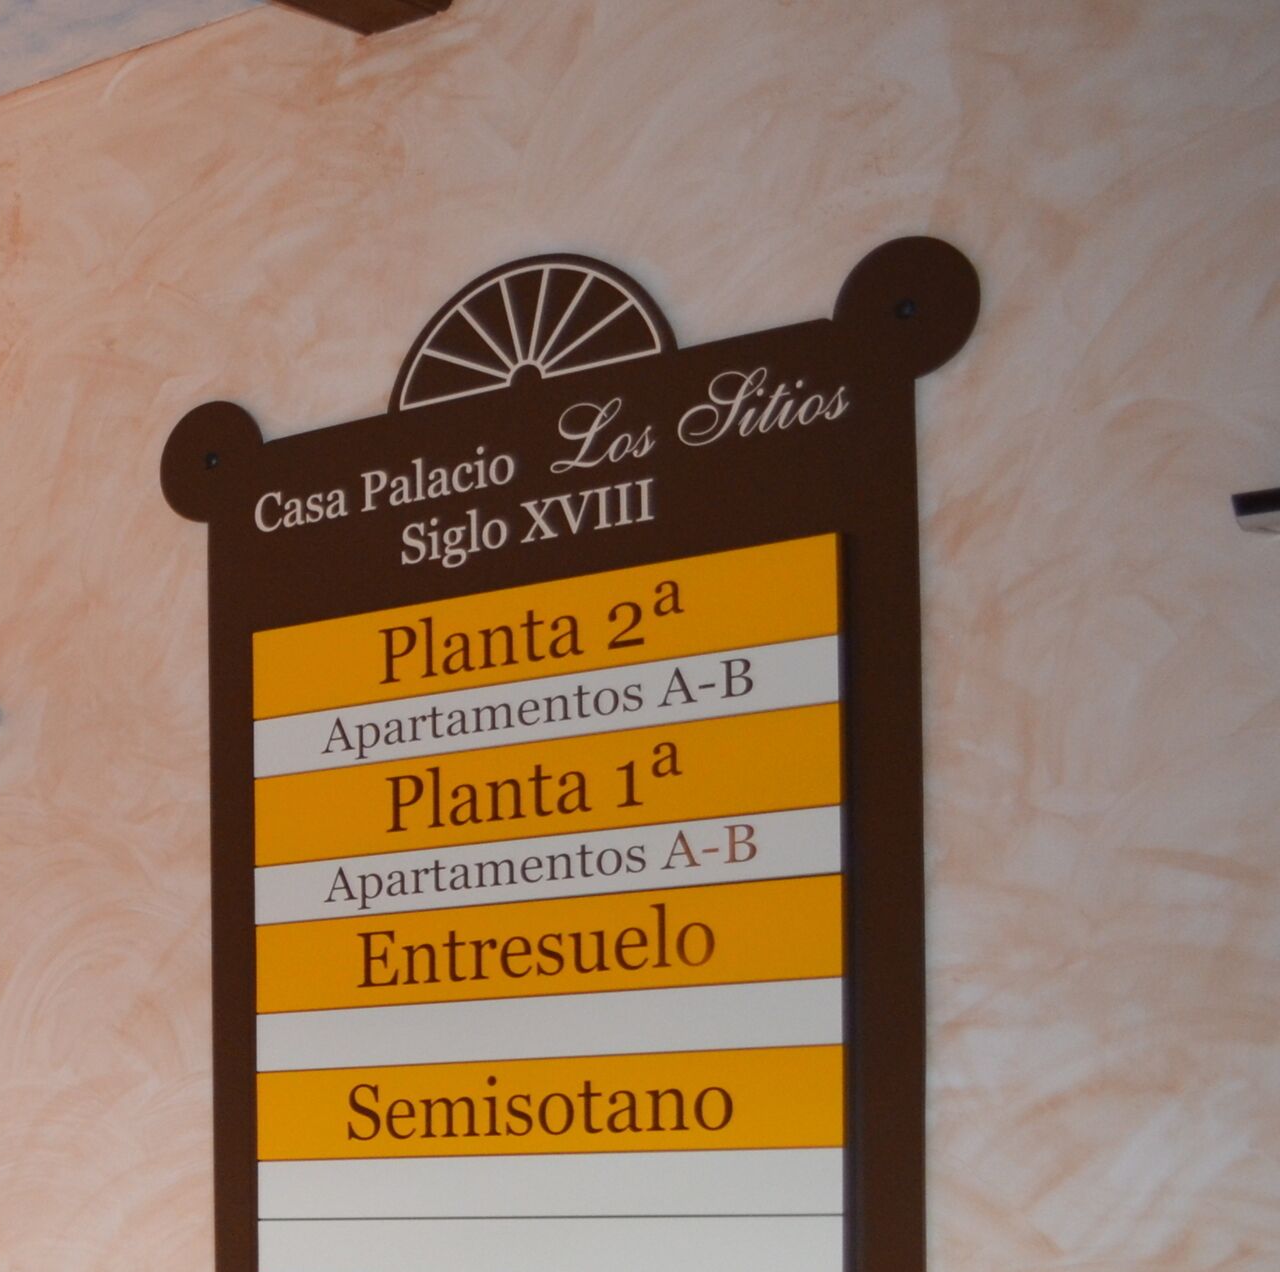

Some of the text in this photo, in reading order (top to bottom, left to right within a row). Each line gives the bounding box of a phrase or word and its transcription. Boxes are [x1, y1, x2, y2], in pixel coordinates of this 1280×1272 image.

[253, 366, 850, 534] Casa Palacio Los Sitios
[399, 478, 656, 569] Siglo XVIII
[378, 608, 585, 685] Planta
[321, 657, 755, 760] Apartamentos A-B
[385, 760, 592, 833] Planta
[323, 824, 758, 910] Apartamentos A-B
[356, 903, 716, 988] Entresuelo
[346, 1074, 735, 1142] Semisotano
